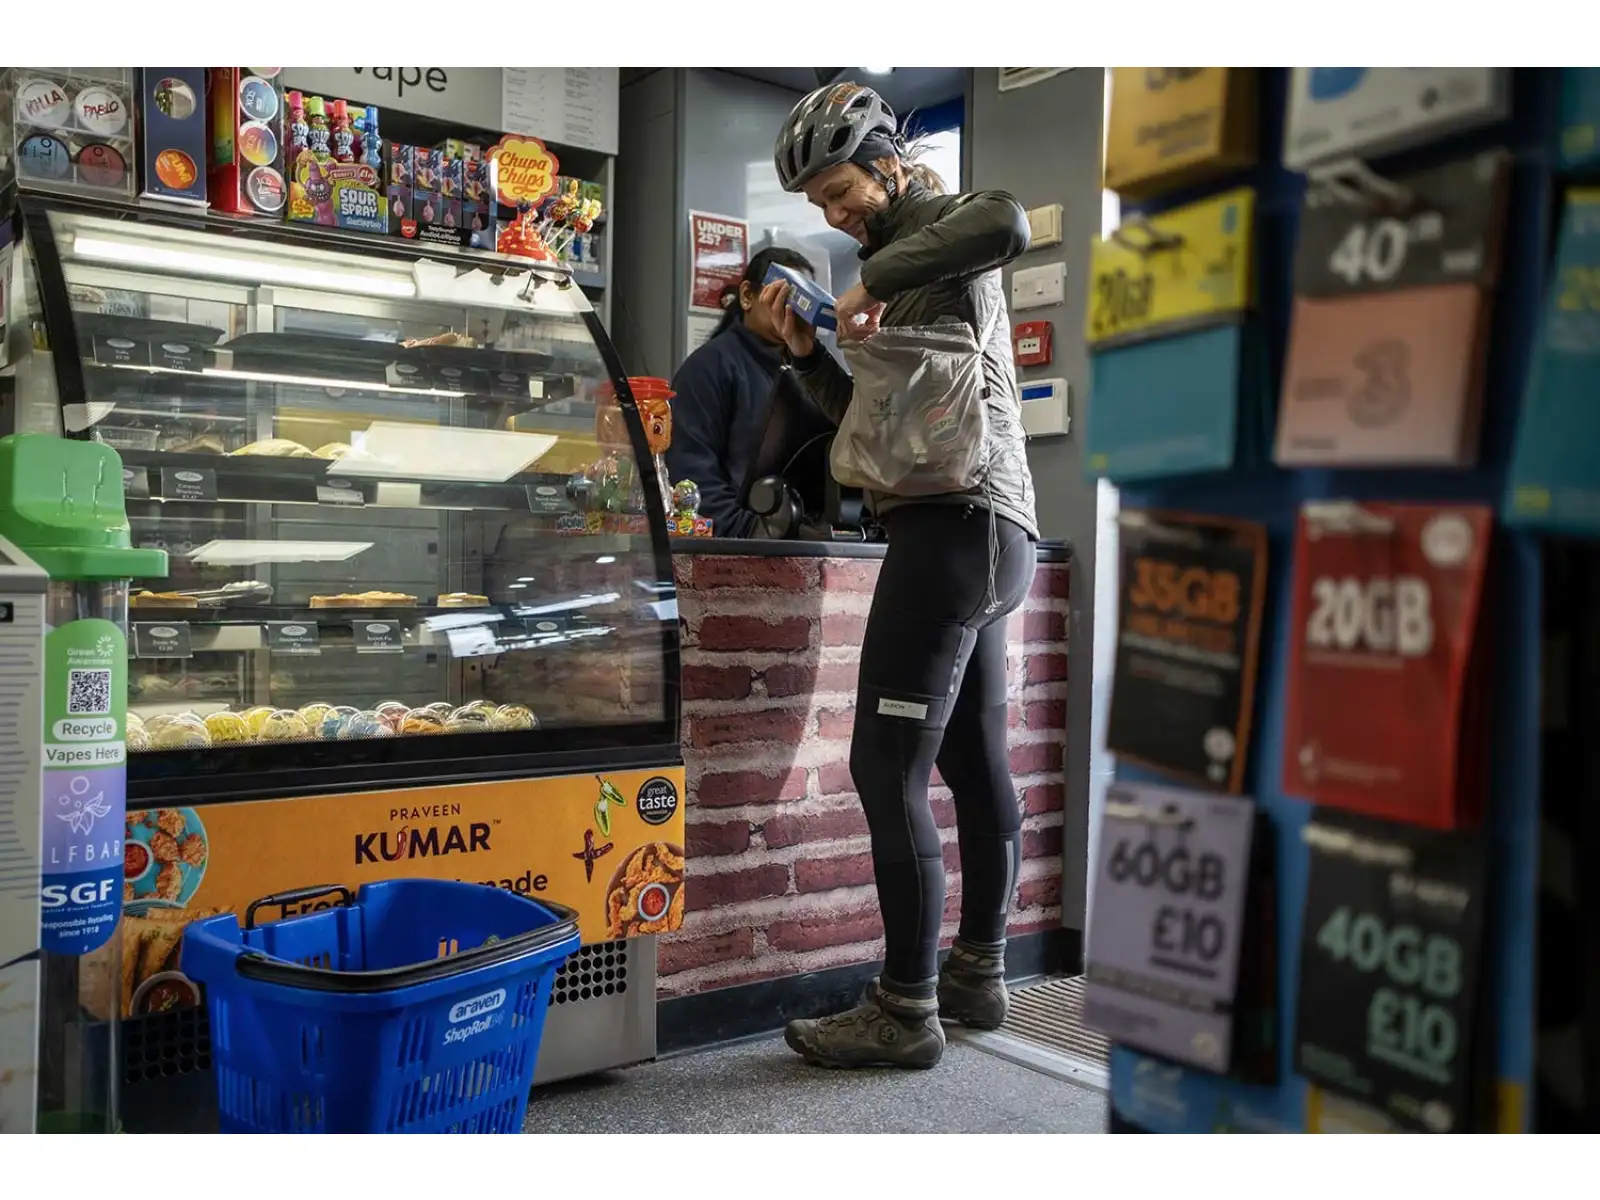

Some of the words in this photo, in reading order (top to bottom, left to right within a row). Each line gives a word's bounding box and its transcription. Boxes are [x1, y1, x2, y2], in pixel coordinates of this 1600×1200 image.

[354, 67, 447, 98] ape
[25, 90, 63, 117] KILLA
[83, 101, 120, 120] PABLO
[499, 151, 547, 174] Chupa
[499, 168, 545, 194] Chups
[340, 188, 376, 206] SOUR
[341, 203, 377, 218] SPRAY
[697, 220, 743, 238] UNDER
[698, 231, 721, 246] 25?
[1328, 217, 1408, 285] 40
[1130, 557, 1240, 624] 35GB
[1307, 575, 1434, 657] 20GB
[62, 722, 112, 738] Recycle
[46, 749, 92, 763] Vapes
[96, 746, 119, 760] Here
[639, 795, 676, 810] taste
[646, 786, 667, 798] great
[390, 803, 461, 821] PRAVEEN
[51, 840, 120, 865] LFBAR
[355, 823, 491, 865] KUMAR
[1107, 838, 1225, 901] 60GB
[42, 879, 114, 907] SGF
[43, 918, 86, 929] esponsible
[59, 928, 80, 938] since
[1151, 906, 1225, 962] £10
[1317, 904, 1462, 997] 40GB
[455, 993, 501, 1018] araven
[442, 1014, 493, 1046] ShopRoll
[1368, 988, 1458, 1066] £10
